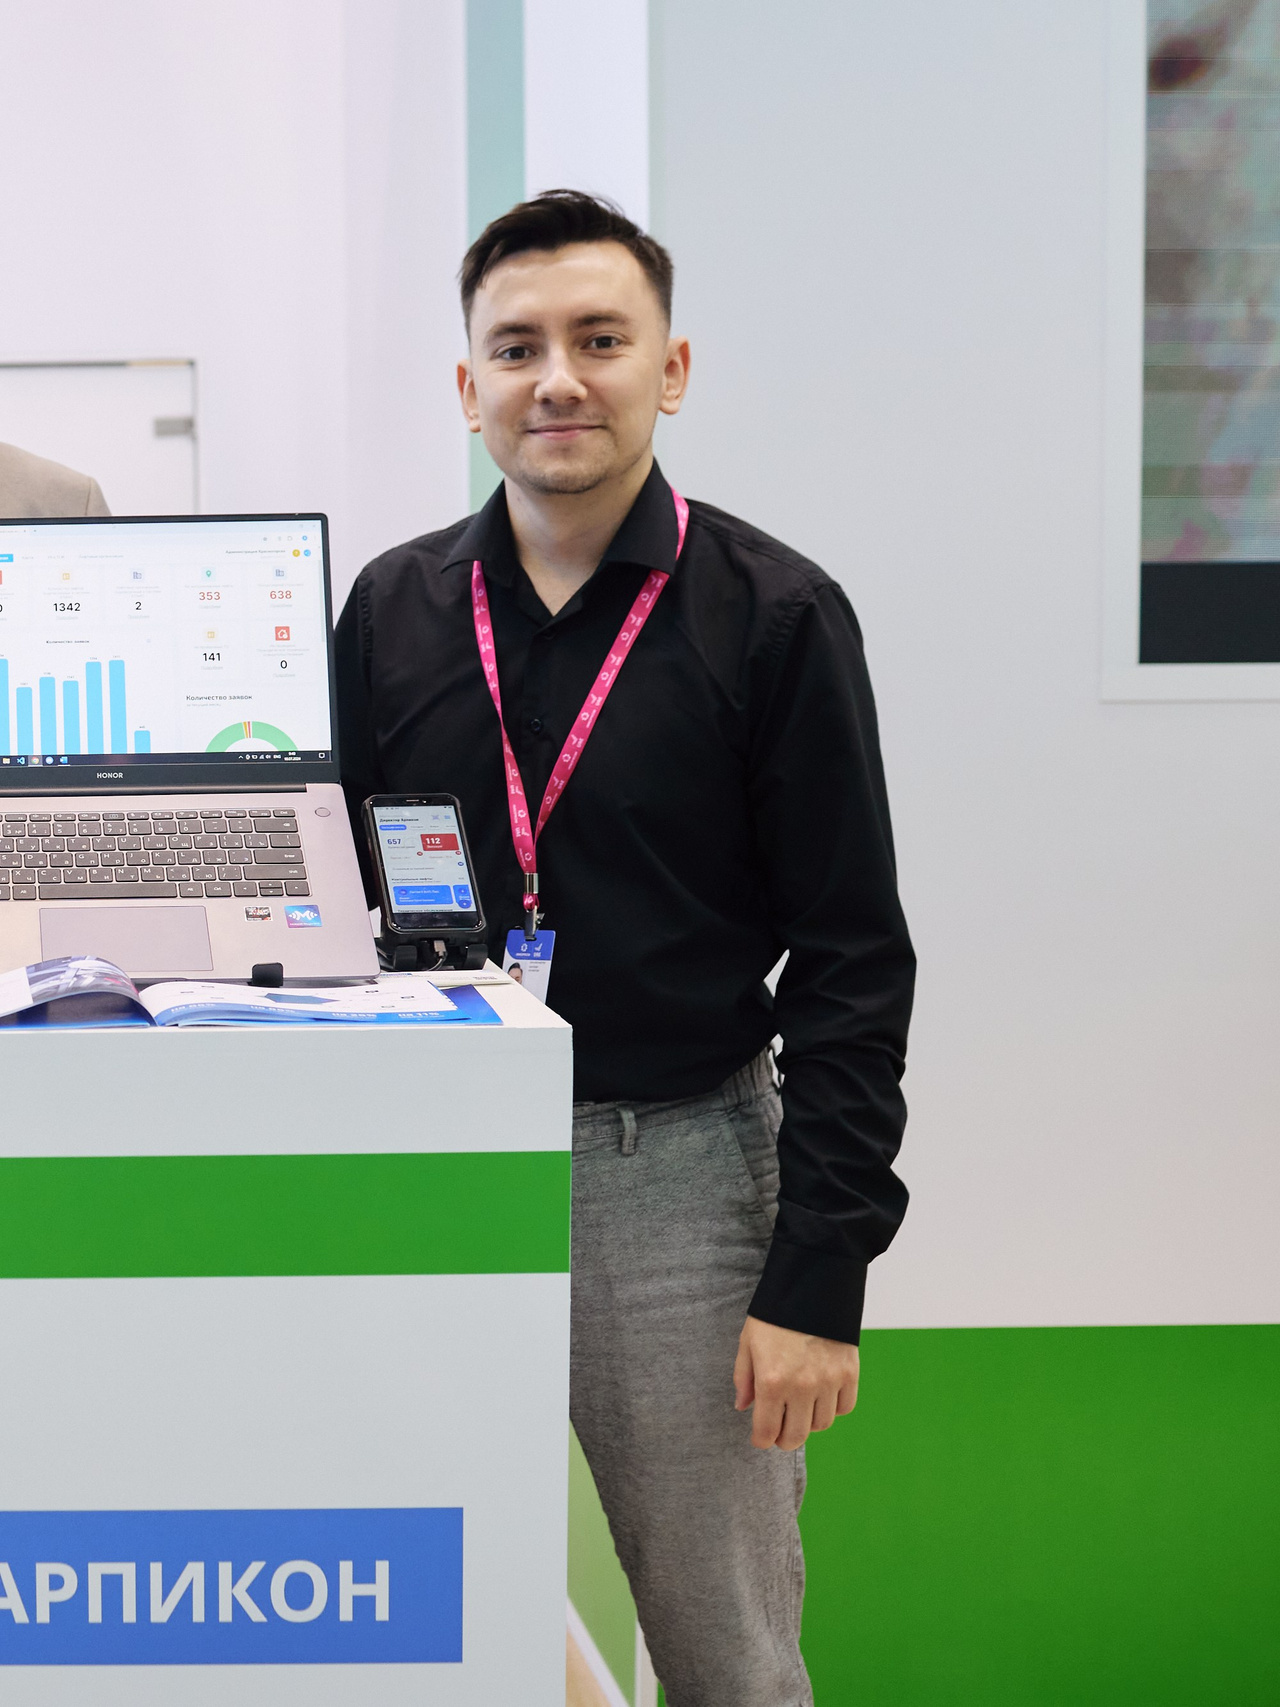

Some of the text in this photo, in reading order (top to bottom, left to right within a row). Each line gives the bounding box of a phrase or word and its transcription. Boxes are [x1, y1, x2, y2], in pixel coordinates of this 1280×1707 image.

[199, 591, 221, 601] 353
[269, 590, 292, 600] 638
[53, 602, 81, 612] 1342
[135, 601, 142, 611] 2
[202, 652, 221, 661] 141
[280, 660, 288, 669] 0
